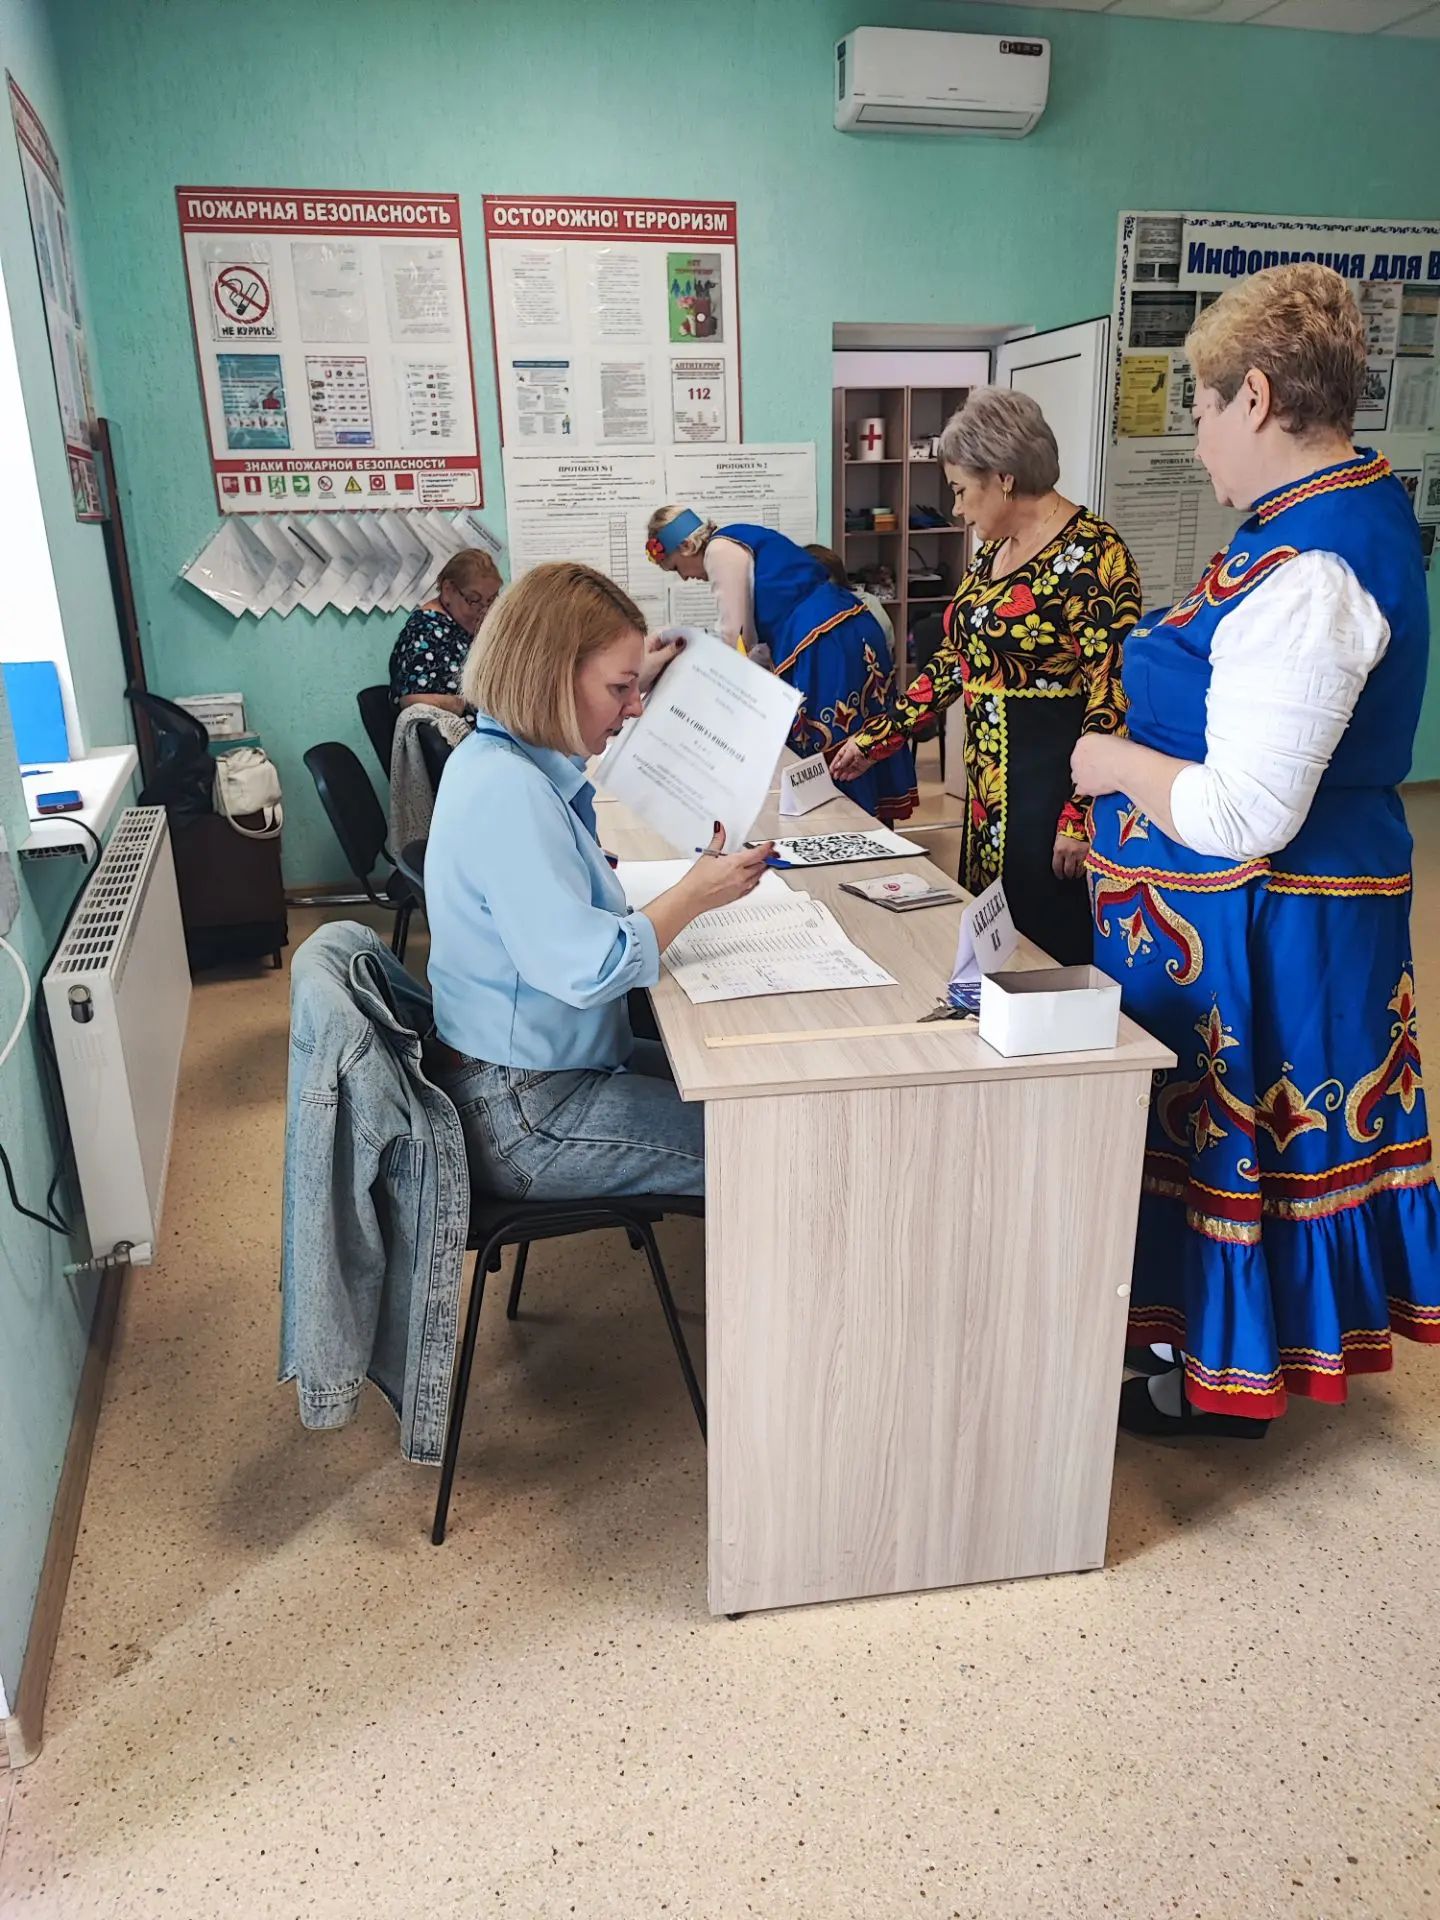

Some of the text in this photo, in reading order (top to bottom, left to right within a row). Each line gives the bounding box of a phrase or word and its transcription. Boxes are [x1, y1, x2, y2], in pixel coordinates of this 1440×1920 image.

[187, 200, 451, 225] ПОЖАРНАЯ БЕЗОПАСНОСТЬ
[493, 207, 728, 231] ОСТОРОЖНО! ТЕРРОРИЗМ
[1369, 254, 1423, 281] для
[222, 326, 275, 336] НЕ КУРИТЬ!
[688, 387, 712, 401] 112
[244, 458, 446, 472] ЗНАКИ ПОЖАРНОЙ БЕЗОПАСНОСТИ
[558, 464, 600, 473] ПРОТОКОЛ
